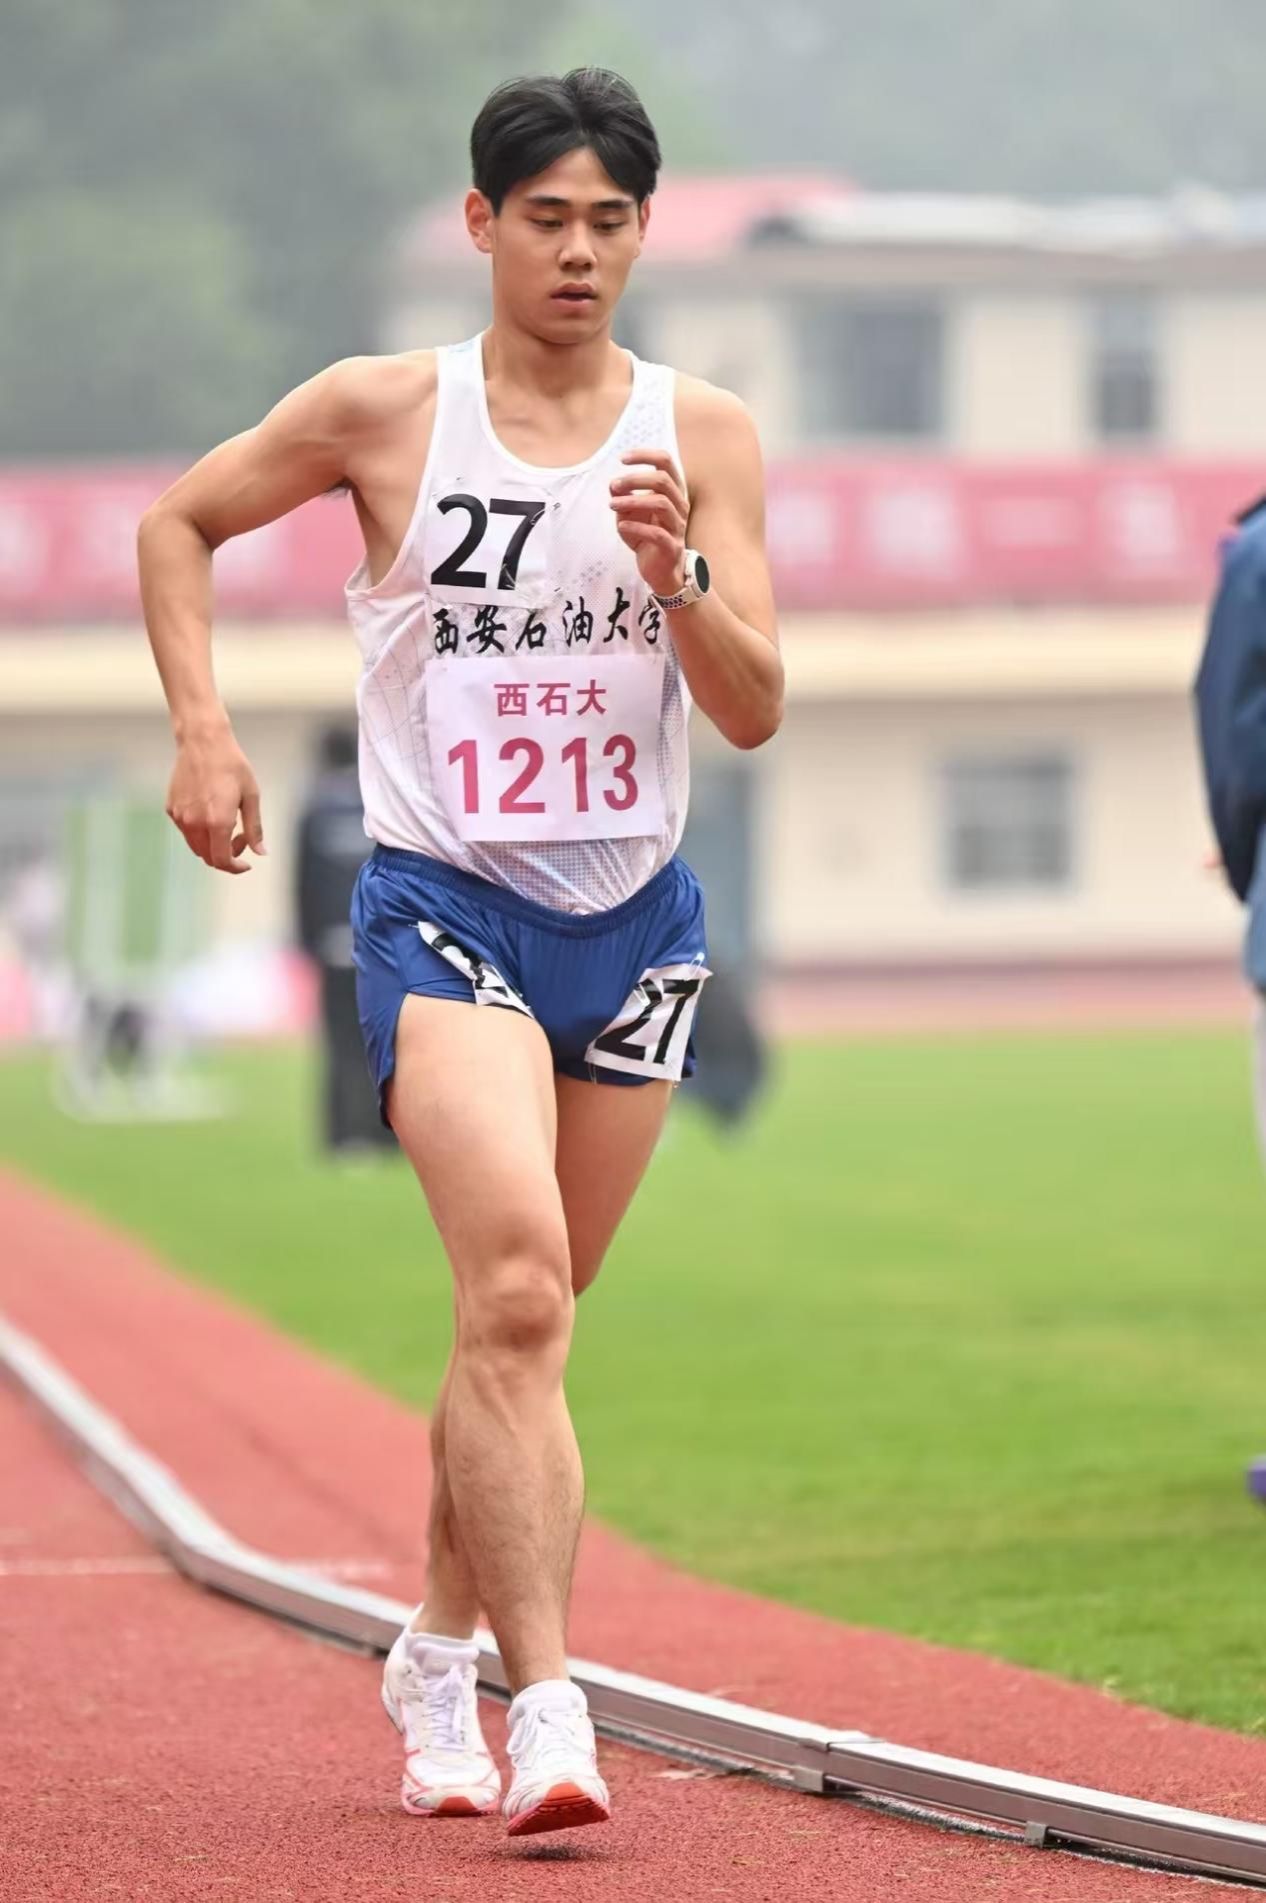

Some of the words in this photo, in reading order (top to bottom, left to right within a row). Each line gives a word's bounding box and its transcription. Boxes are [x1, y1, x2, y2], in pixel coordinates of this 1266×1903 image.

[431, 493, 546, 590] 27
[494, 679, 607, 717] 西石大
[447, 734, 639, 814] 1213
[594, 979, 700, 1065] 27
